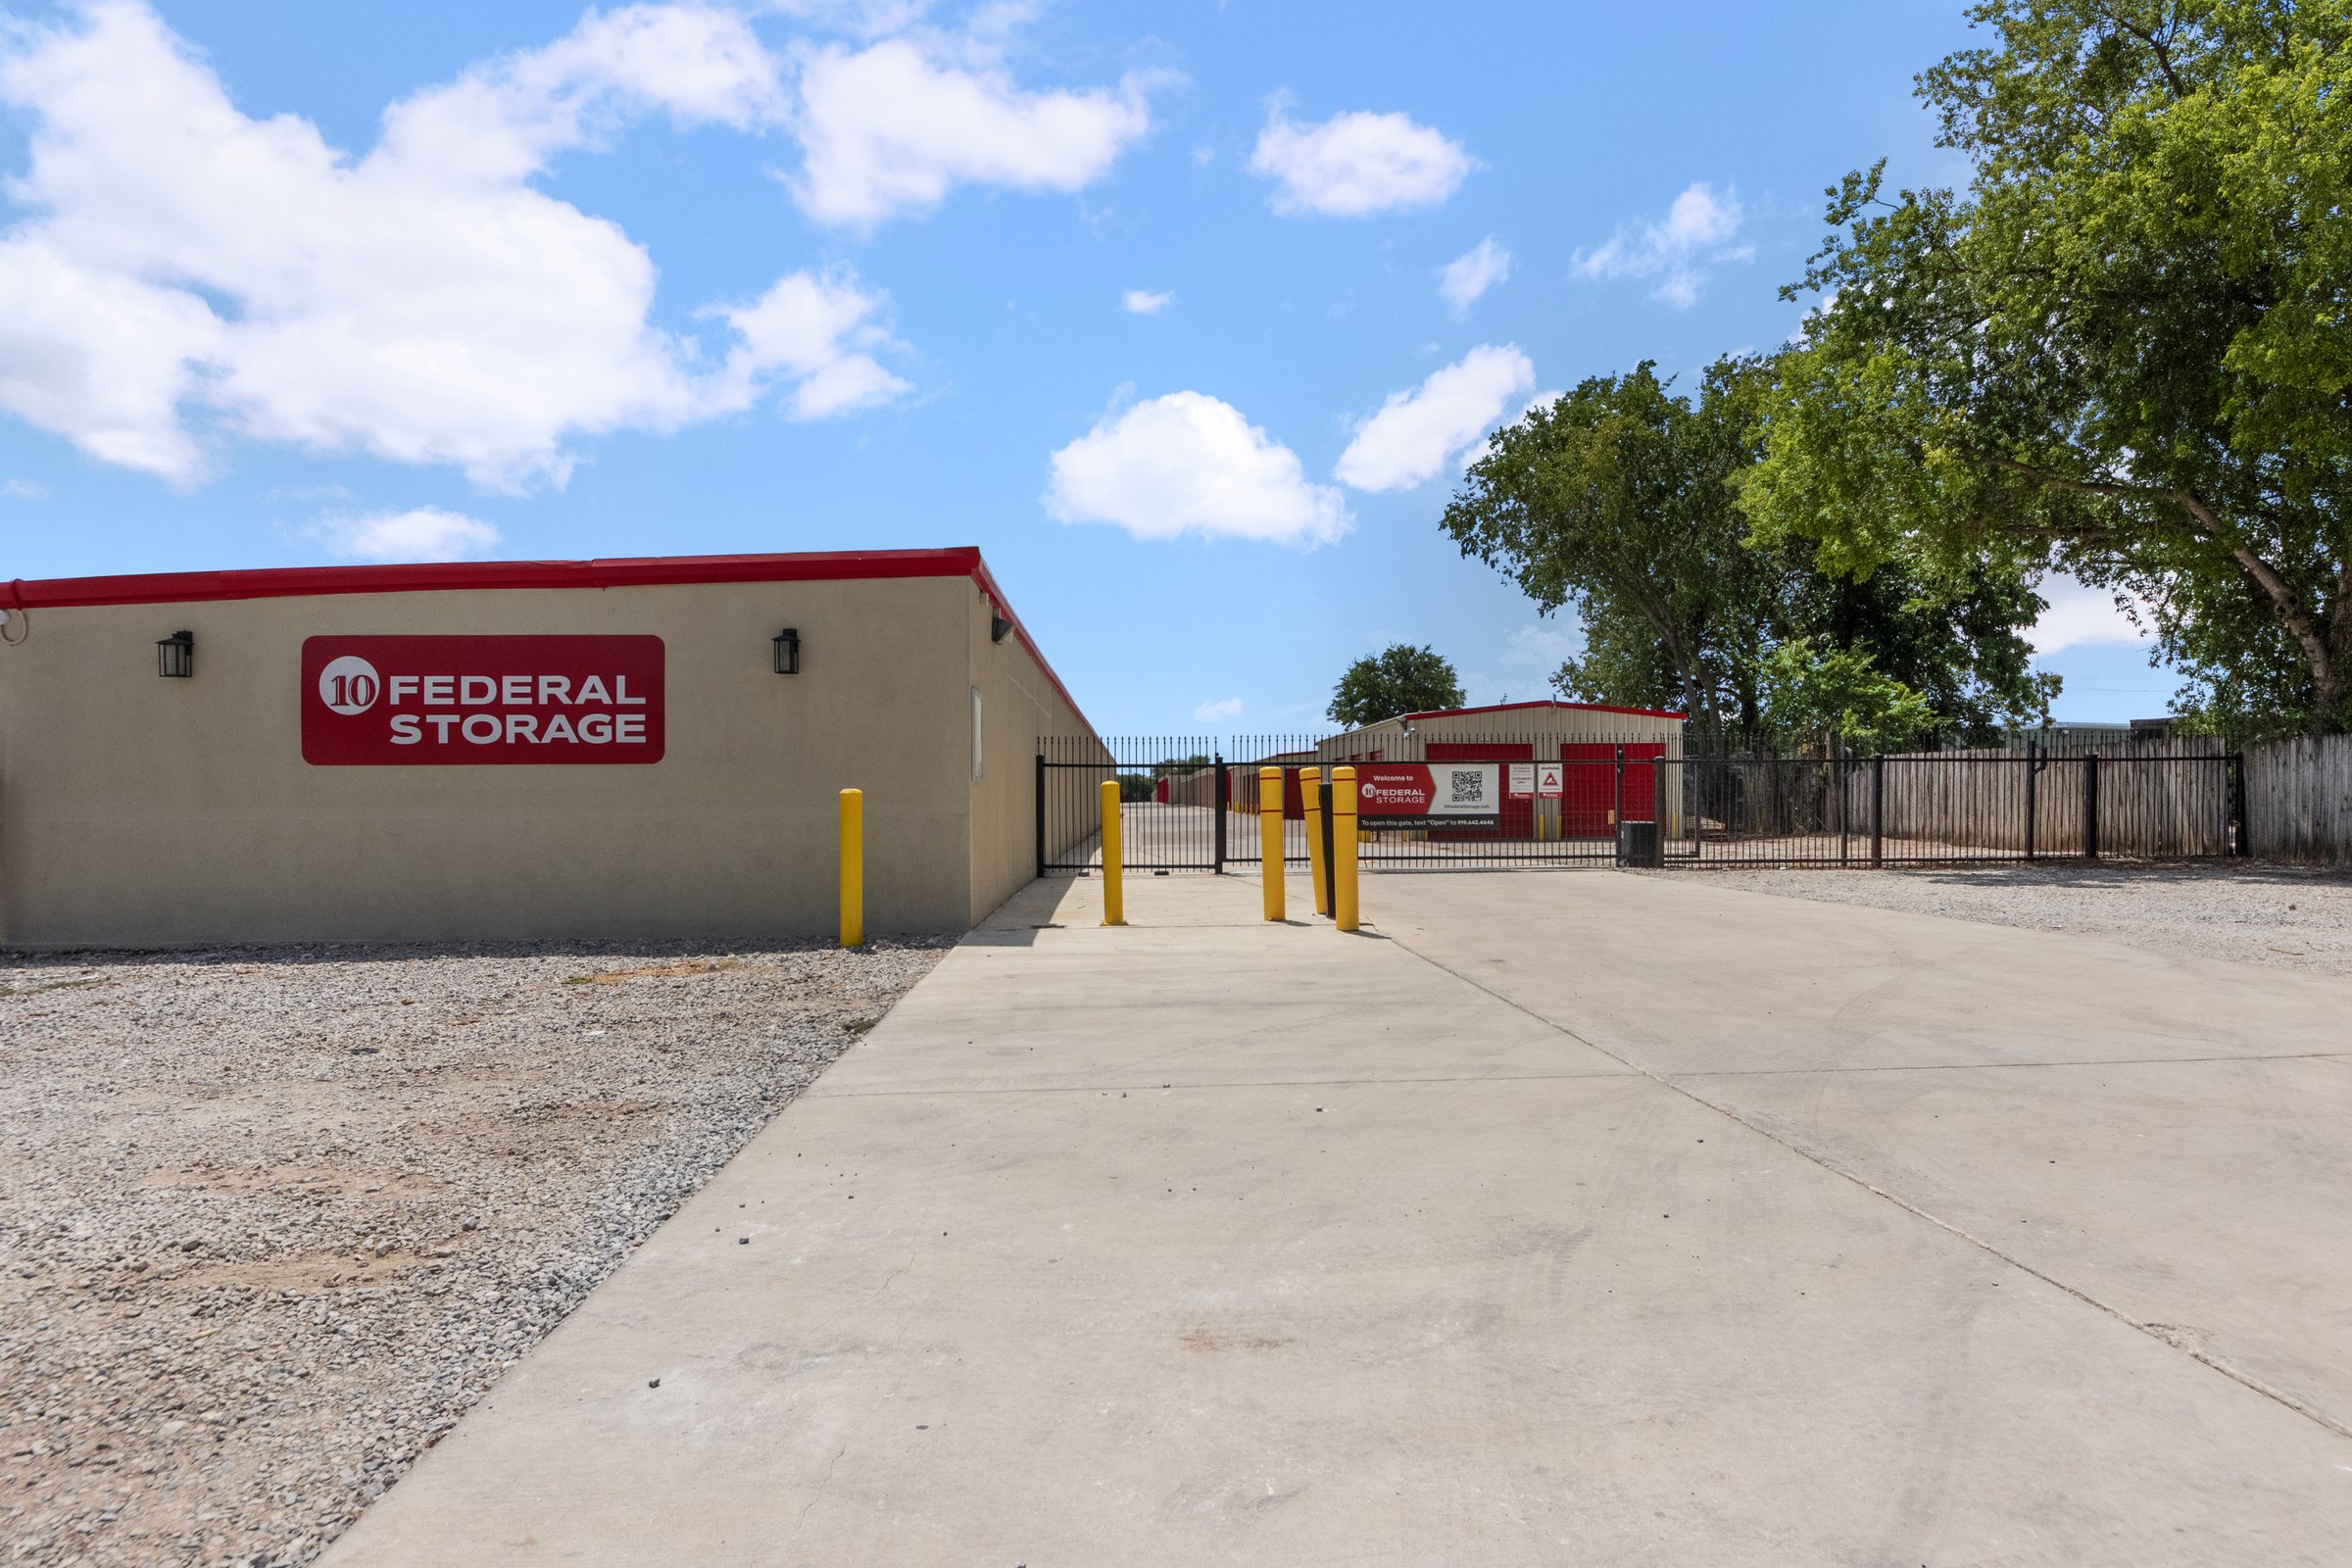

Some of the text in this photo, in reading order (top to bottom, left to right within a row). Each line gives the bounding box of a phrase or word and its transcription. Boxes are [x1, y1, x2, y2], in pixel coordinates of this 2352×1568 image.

[329, 675, 647, 707] 10 FEDERAL
[389, 713, 647, 745] STORAGE
[1365, 787, 1376, 796] 10
